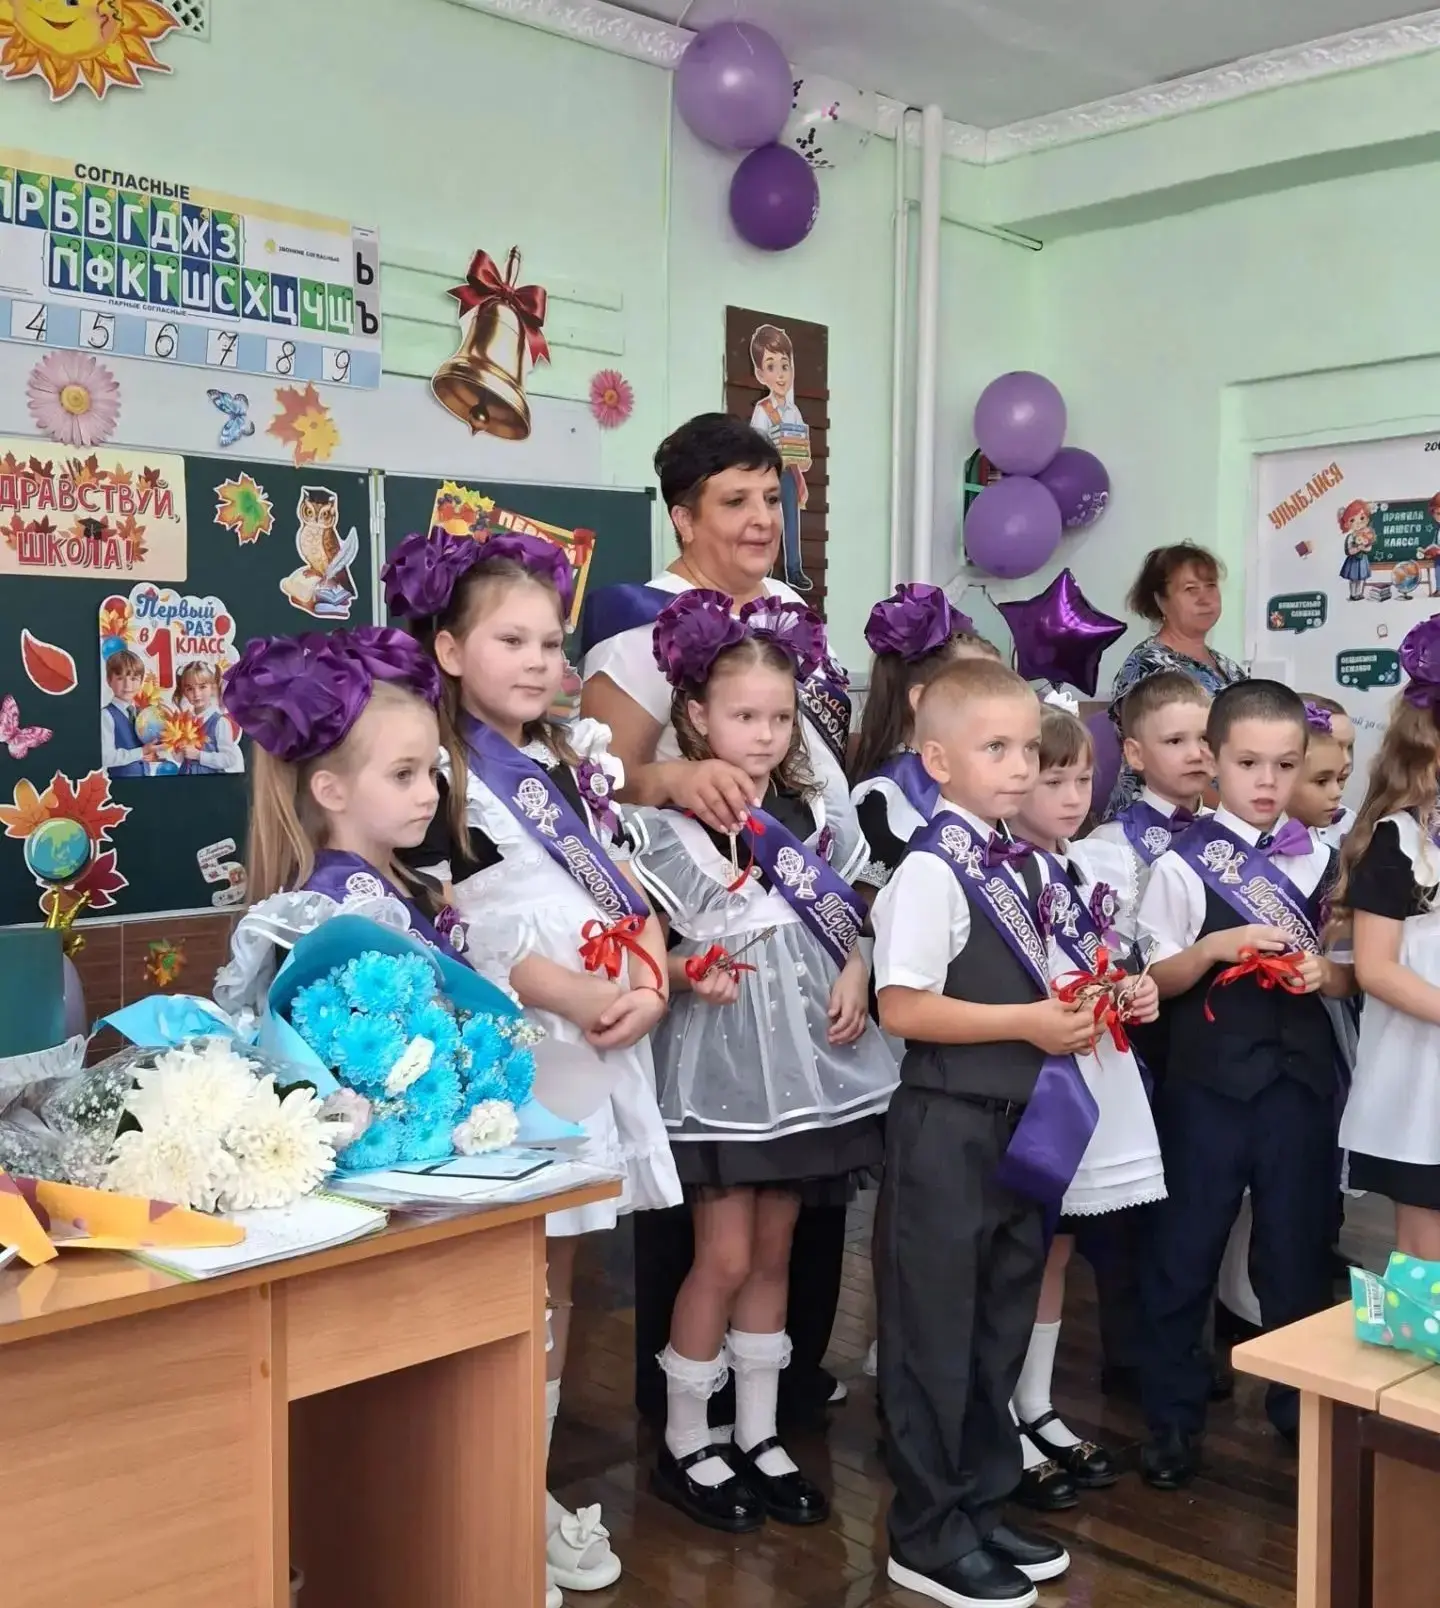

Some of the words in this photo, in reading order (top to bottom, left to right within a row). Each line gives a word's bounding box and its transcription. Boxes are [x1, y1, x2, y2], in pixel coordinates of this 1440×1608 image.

[75, 163, 190, 200] СОГЛАСНЫЕ
[109, 299, 140, 310] ПАРНЫЕ
[143, 304, 187, 316] СОГЛАСНЫЕ
[26, 304, 47, 341] 4
[88, 313, 115, 348] 5
[155, 323, 178, 358] 6
[218, 331, 238, 365] 7
[276, 341, 296, 374] 8
[332, 350, 351, 382] 9
[1268, 461, 1344, 530] УЛЫБАЙСЯ
[1382, 510, 1424, 522] ПРАВИЛА
[1383, 524, 1421, 534] НАШЕГО
[16, 531, 134, 570] ШКОЛА!
[1384, 536, 1420, 547] КЛАССА
[136, 593, 215, 625] Первый
[186, 620, 213, 636] РАЗ
[146, 628, 173, 688] 1
[175, 637, 225, 654] КЛАСС
[814, 892, 859, 951] Перво
